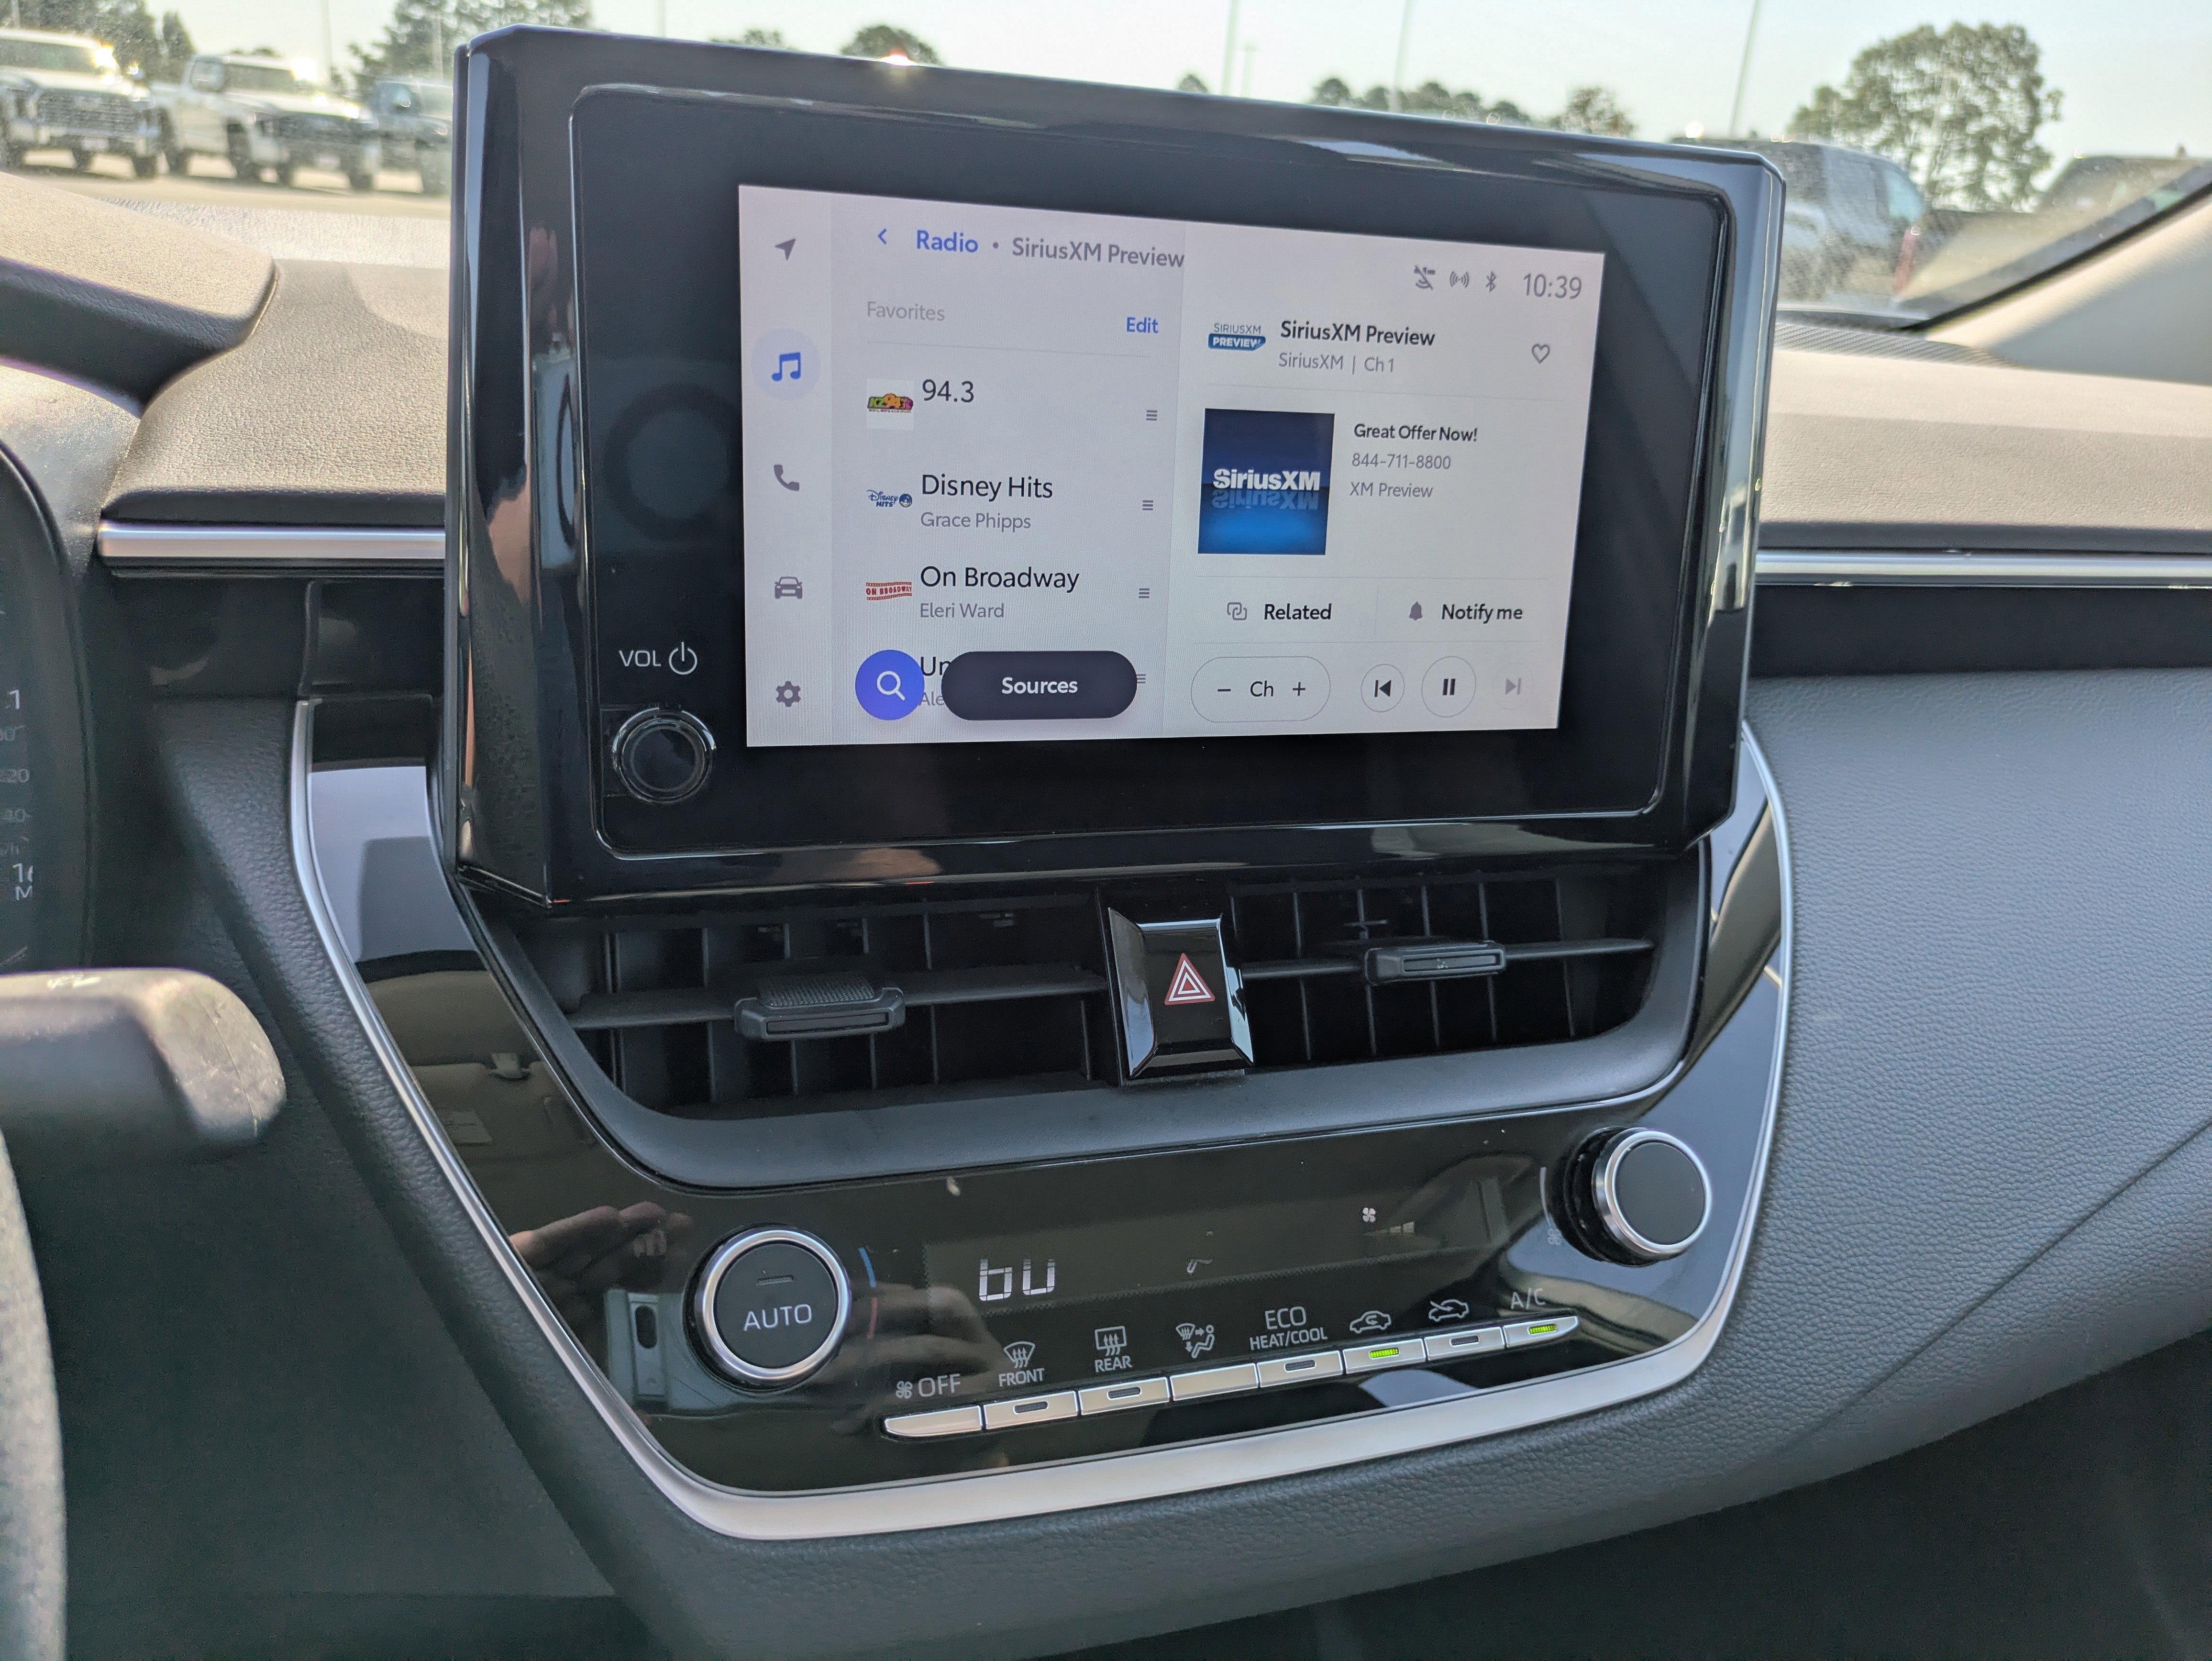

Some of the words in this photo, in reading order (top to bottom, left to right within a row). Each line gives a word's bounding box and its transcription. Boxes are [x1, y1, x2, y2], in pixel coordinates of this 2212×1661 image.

[917, 230, 978, 253] Radio
[1013, 238, 1101, 262] SiriusXM
[1108, 244, 1184, 267] Preview
[1524, 274, 1582, 299] 10:39
[867, 301, 945, 321] Favorites
[1127, 317, 1158, 333] Edit
[1214, 323, 1261, 335] SIRIUSXM
[1281, 321, 1360, 342] SiriusXM
[1366, 325, 1435, 345] Preview
[1213, 337, 1260, 348] PREVIEW
[1279, 352, 1343, 369] SiriusXM
[1364, 357, 1384, 372] Ch
[1389, 358, 1394, 372] 1
[922, 379, 974, 402] 94.3
[1354, 423, 1395, 438] Great
[1399, 425, 1437, 440] Offer
[1439, 427, 1477, 441] Now!
[1352, 453, 1451, 469] 844-711-8800
[923, 474, 1002, 502] Disney
[1009, 476, 1052, 498] Hits
[1213, 469, 1320, 491] SiriusXM
[1350, 482, 1373, 496] XM
[1379, 483, 1433, 498] Preview
[921, 512, 971, 527] Grace
[976, 513, 1030, 532] Phipps
[921, 566, 956, 587] On
[965, 566, 1079, 593] Broadway
[879, 586, 912, 595] BROADWAY
[920, 603, 954, 618] Eleri
[960, 603, 1004, 618] Ward
[1264, 603, 1331, 620] Related
[1442, 604, 1493, 624] Notify
[1497, 609, 1523, 619] me
[619, 650, 661, 666] VOL
[1002, 677, 1077, 694] Sources
[1250, 680, 1273, 697] Ch
[1510, 1288, 1546, 1310] A/C
[744, 1304, 812, 1331] AUTO
[1265, 1307, 1307, 1330] ECO
[1250, 1328, 1328, 1351] HEAT/COOL
[1095, 1355, 1133, 1372] REAR
[918, 1373, 962, 1397] OFF
[998, 1368, 1045, 1387] FRONT
